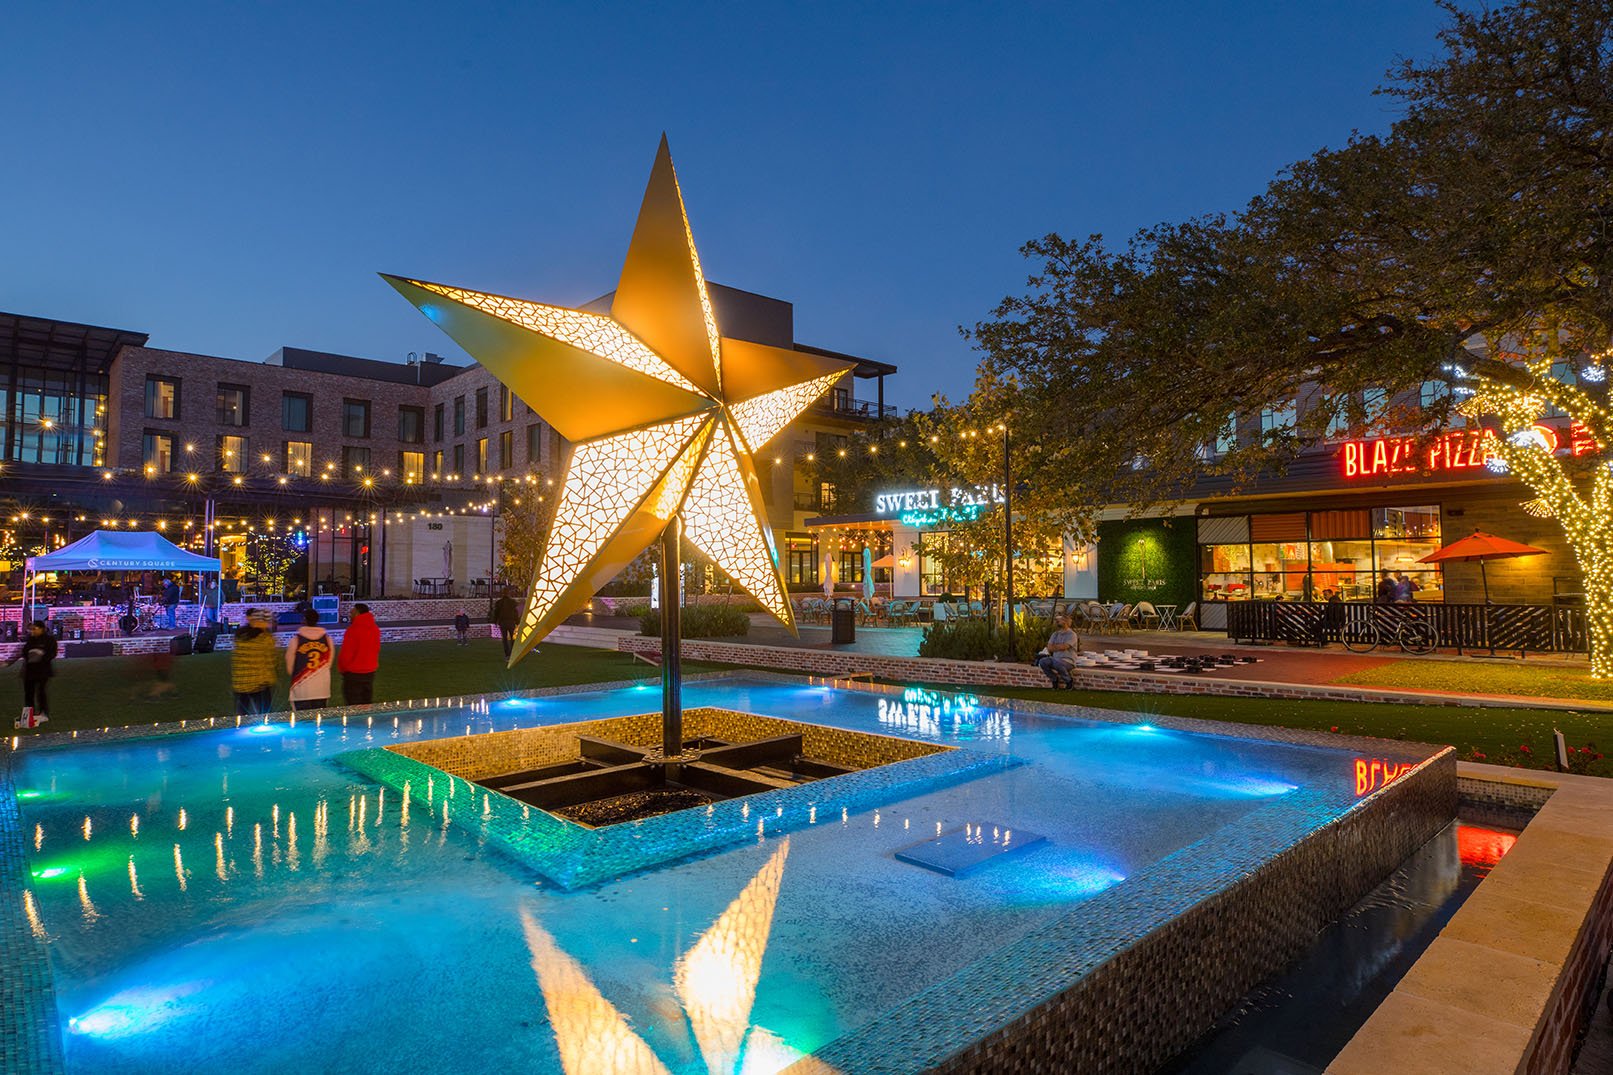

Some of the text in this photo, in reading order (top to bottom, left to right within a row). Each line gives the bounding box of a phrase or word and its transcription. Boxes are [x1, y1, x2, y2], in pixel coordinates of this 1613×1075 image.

[876, 489, 940, 513] SWEET
[143, 560, 176, 568] SQUARE
[306, 651, 321, 669] 3
